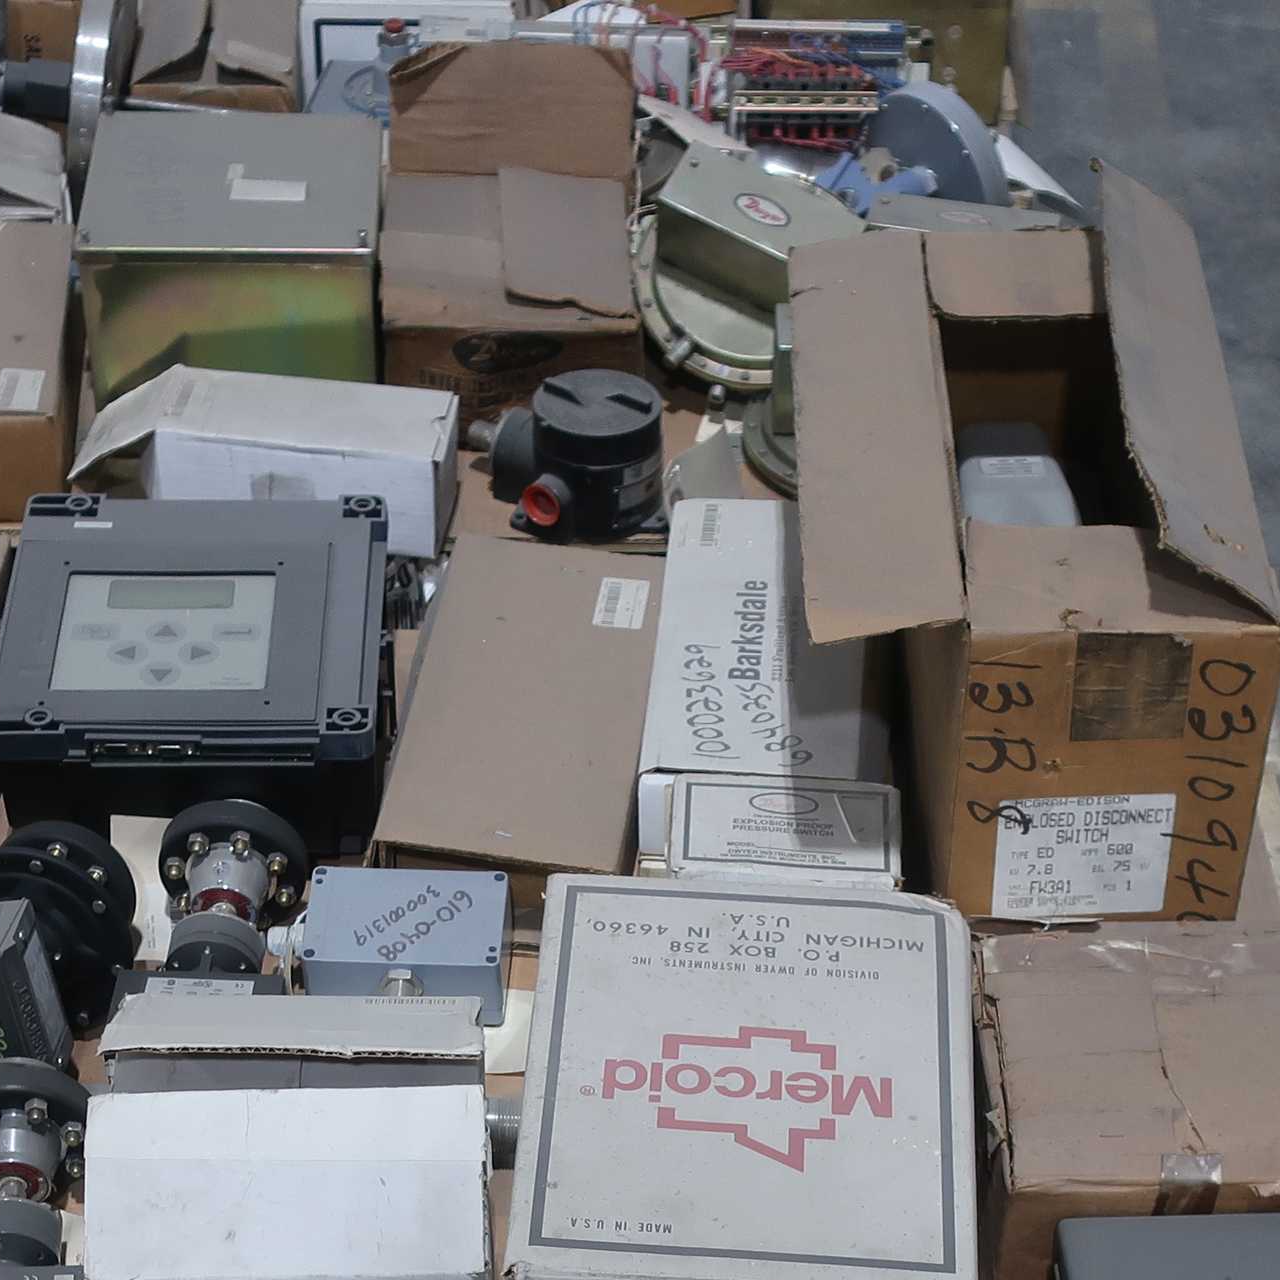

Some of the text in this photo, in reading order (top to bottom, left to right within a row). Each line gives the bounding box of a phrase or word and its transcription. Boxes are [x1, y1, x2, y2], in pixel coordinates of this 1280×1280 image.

[728, 580, 768, 680] Barksdale
[733, 818, 794, 828] EXPLOSION
[1083, 808, 1172, 827] DISCONNECT
[732, 825, 791, 834] PRESSURE
[1055, 828, 1109, 844] SWITCH
[1037, 847, 1055, 859] ED
[1027, 864, 1053, 875] 7.8
[1112, 860, 1131, 871] 75
[722, 913, 790, 929] U.S.A.
[586, 918, 924, 953] MICHIGAN CITY, IN 46360,
[669, 940, 840, 963] P.O. BOX 258
[755, 964, 796, 976] DWYER
[804, 967, 818, 977] OF
[827, 968, 880, 980] DIVISION
[600, 1058, 893, 1118] Mercoid
[566, 1216, 672, 1234] MADE IN U.S.A.
